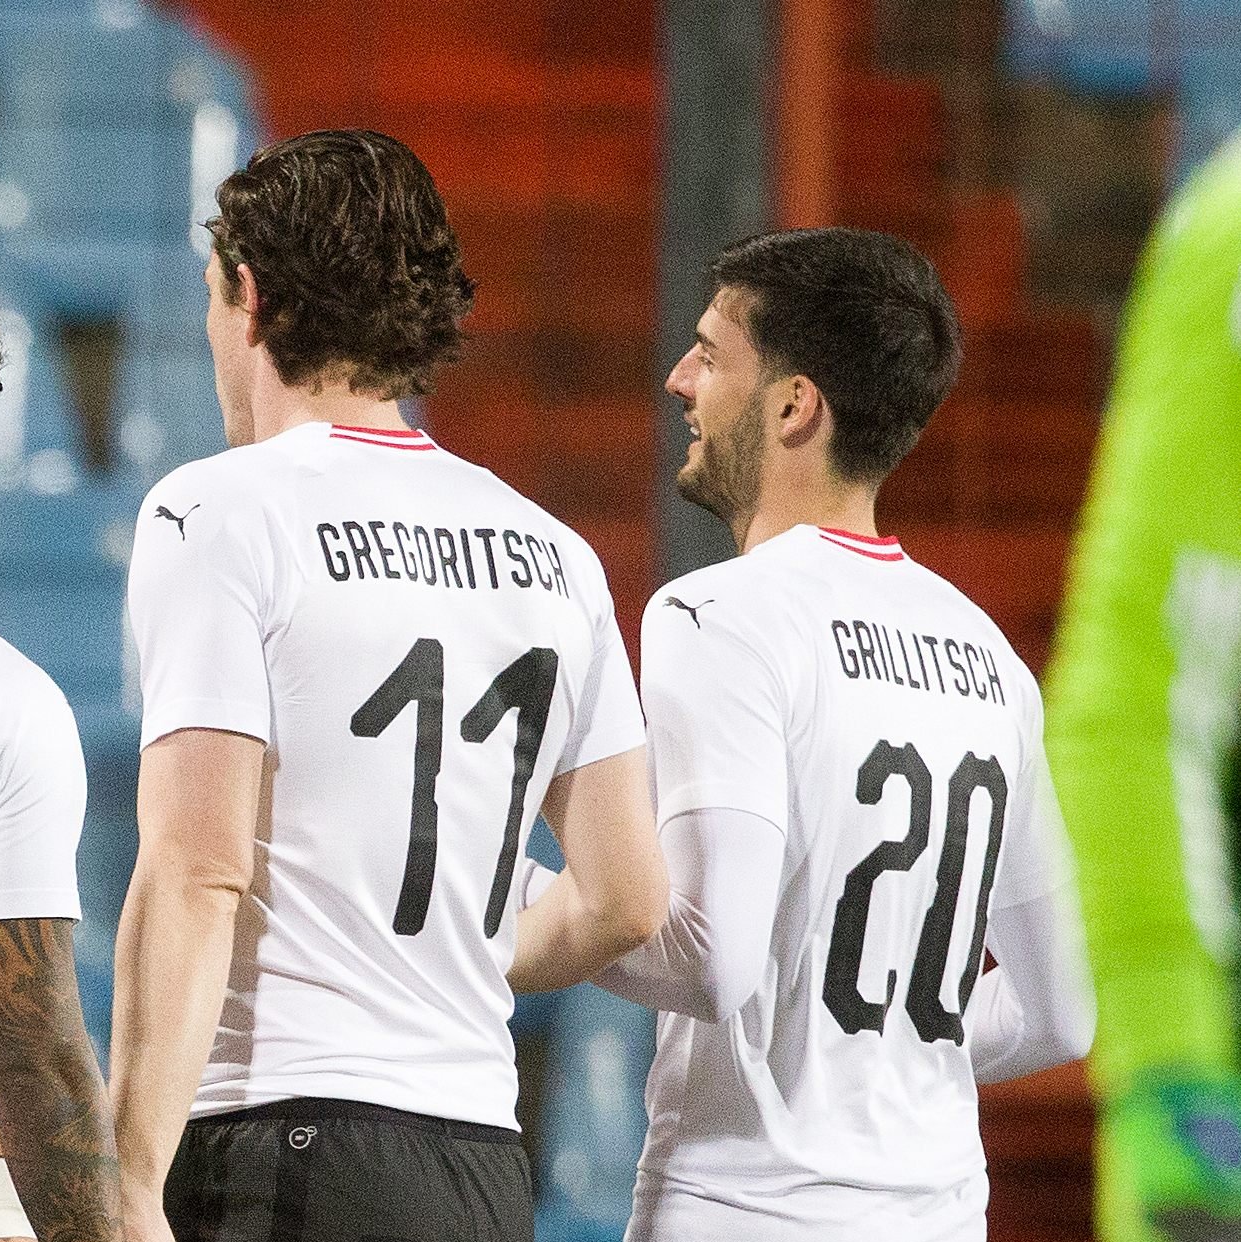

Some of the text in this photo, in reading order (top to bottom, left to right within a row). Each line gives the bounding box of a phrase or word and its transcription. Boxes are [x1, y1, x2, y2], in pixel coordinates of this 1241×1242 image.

[316, 521, 570, 599] GREGORITSCH
[831, 619, 1006, 706] GRILLITSCH
[350, 638, 558, 939] 11
[822, 739, 1008, 1047] 20
